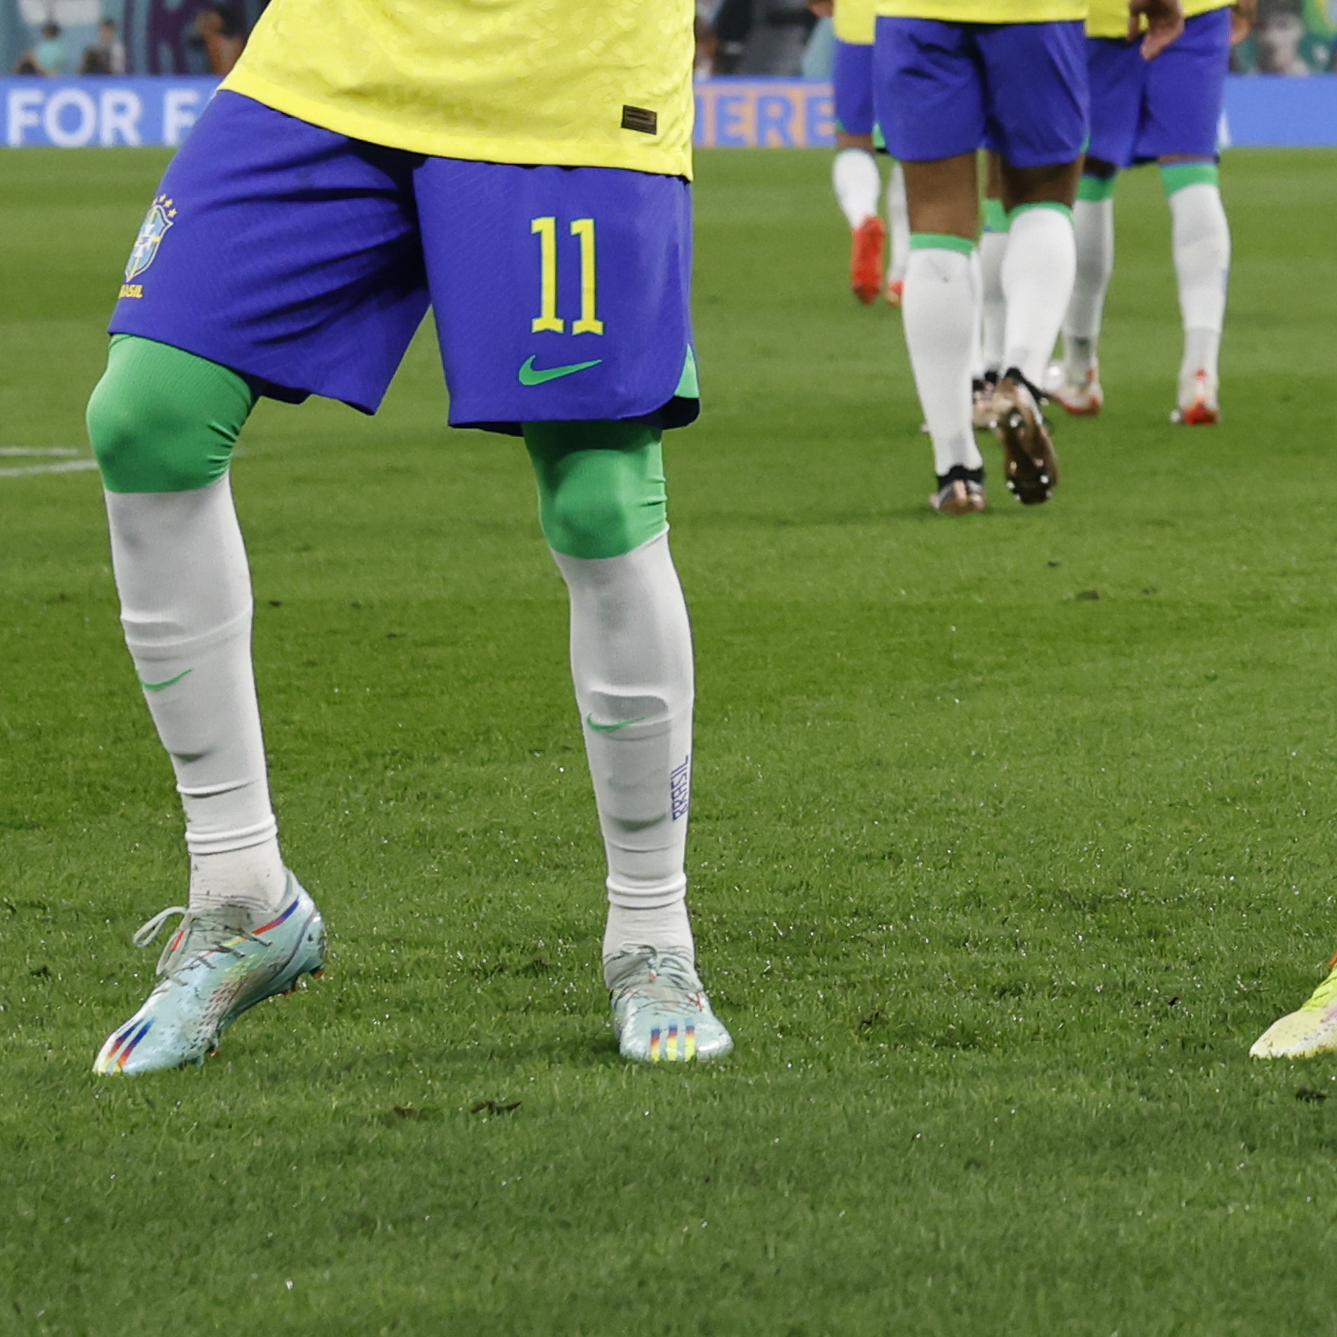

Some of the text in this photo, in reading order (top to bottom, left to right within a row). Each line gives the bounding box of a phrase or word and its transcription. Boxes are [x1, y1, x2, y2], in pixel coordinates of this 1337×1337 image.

[7, 87, 142, 148] FOR
[693, 94, 837, 148] ERE
[530, 216, 605, 336] 11
[670, 754, 689, 822] BRASIL
